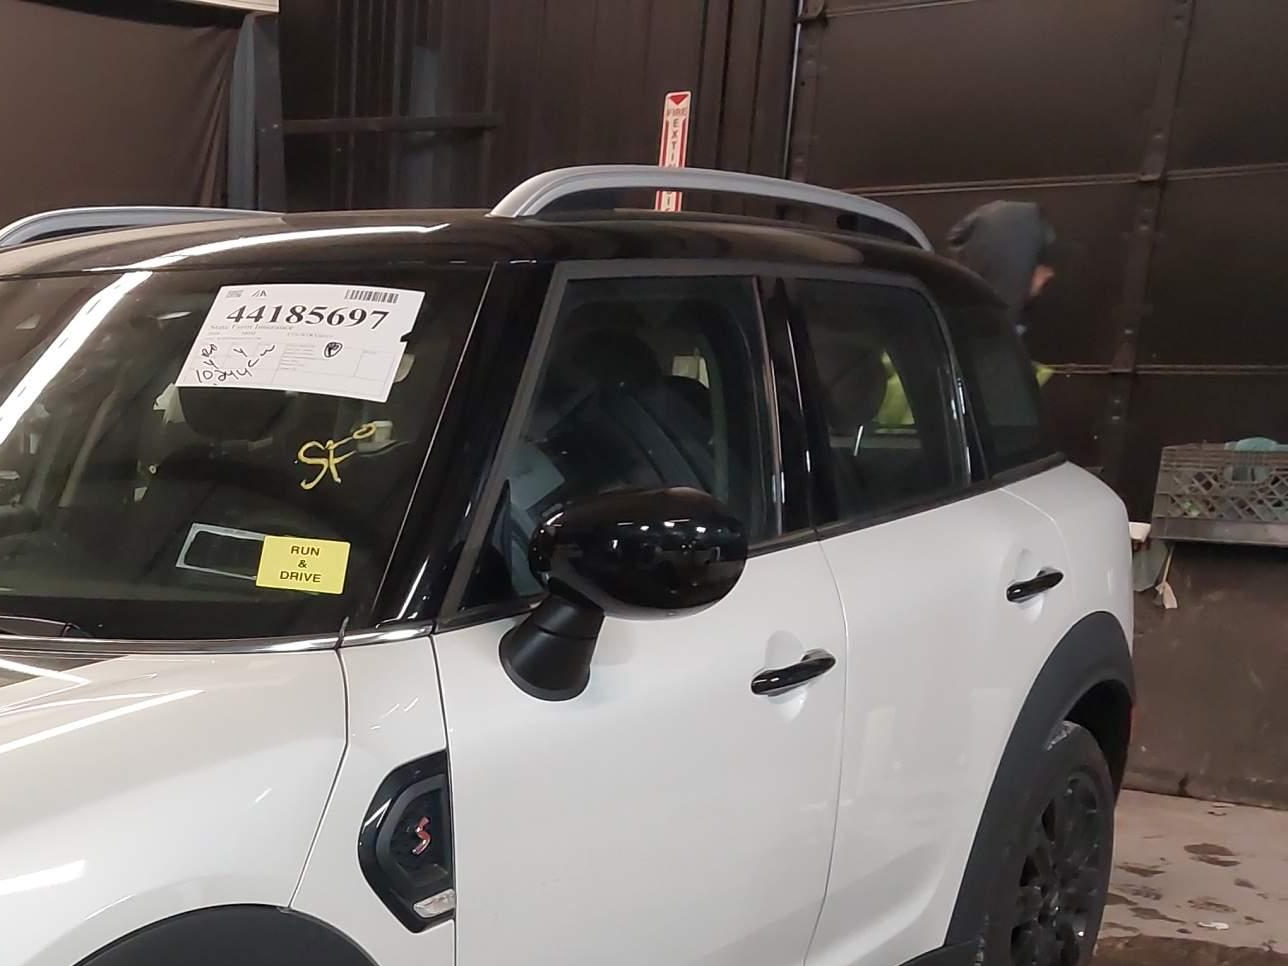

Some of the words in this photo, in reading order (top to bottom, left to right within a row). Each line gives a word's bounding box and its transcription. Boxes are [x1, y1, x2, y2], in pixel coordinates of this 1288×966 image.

[226, 304, 390, 330] 44185697
[290, 545, 321, 556] RUN
[297, 560, 308, 569] &
[279, 571, 322, 583] DRIVE
[412, 816, 432, 855] S
